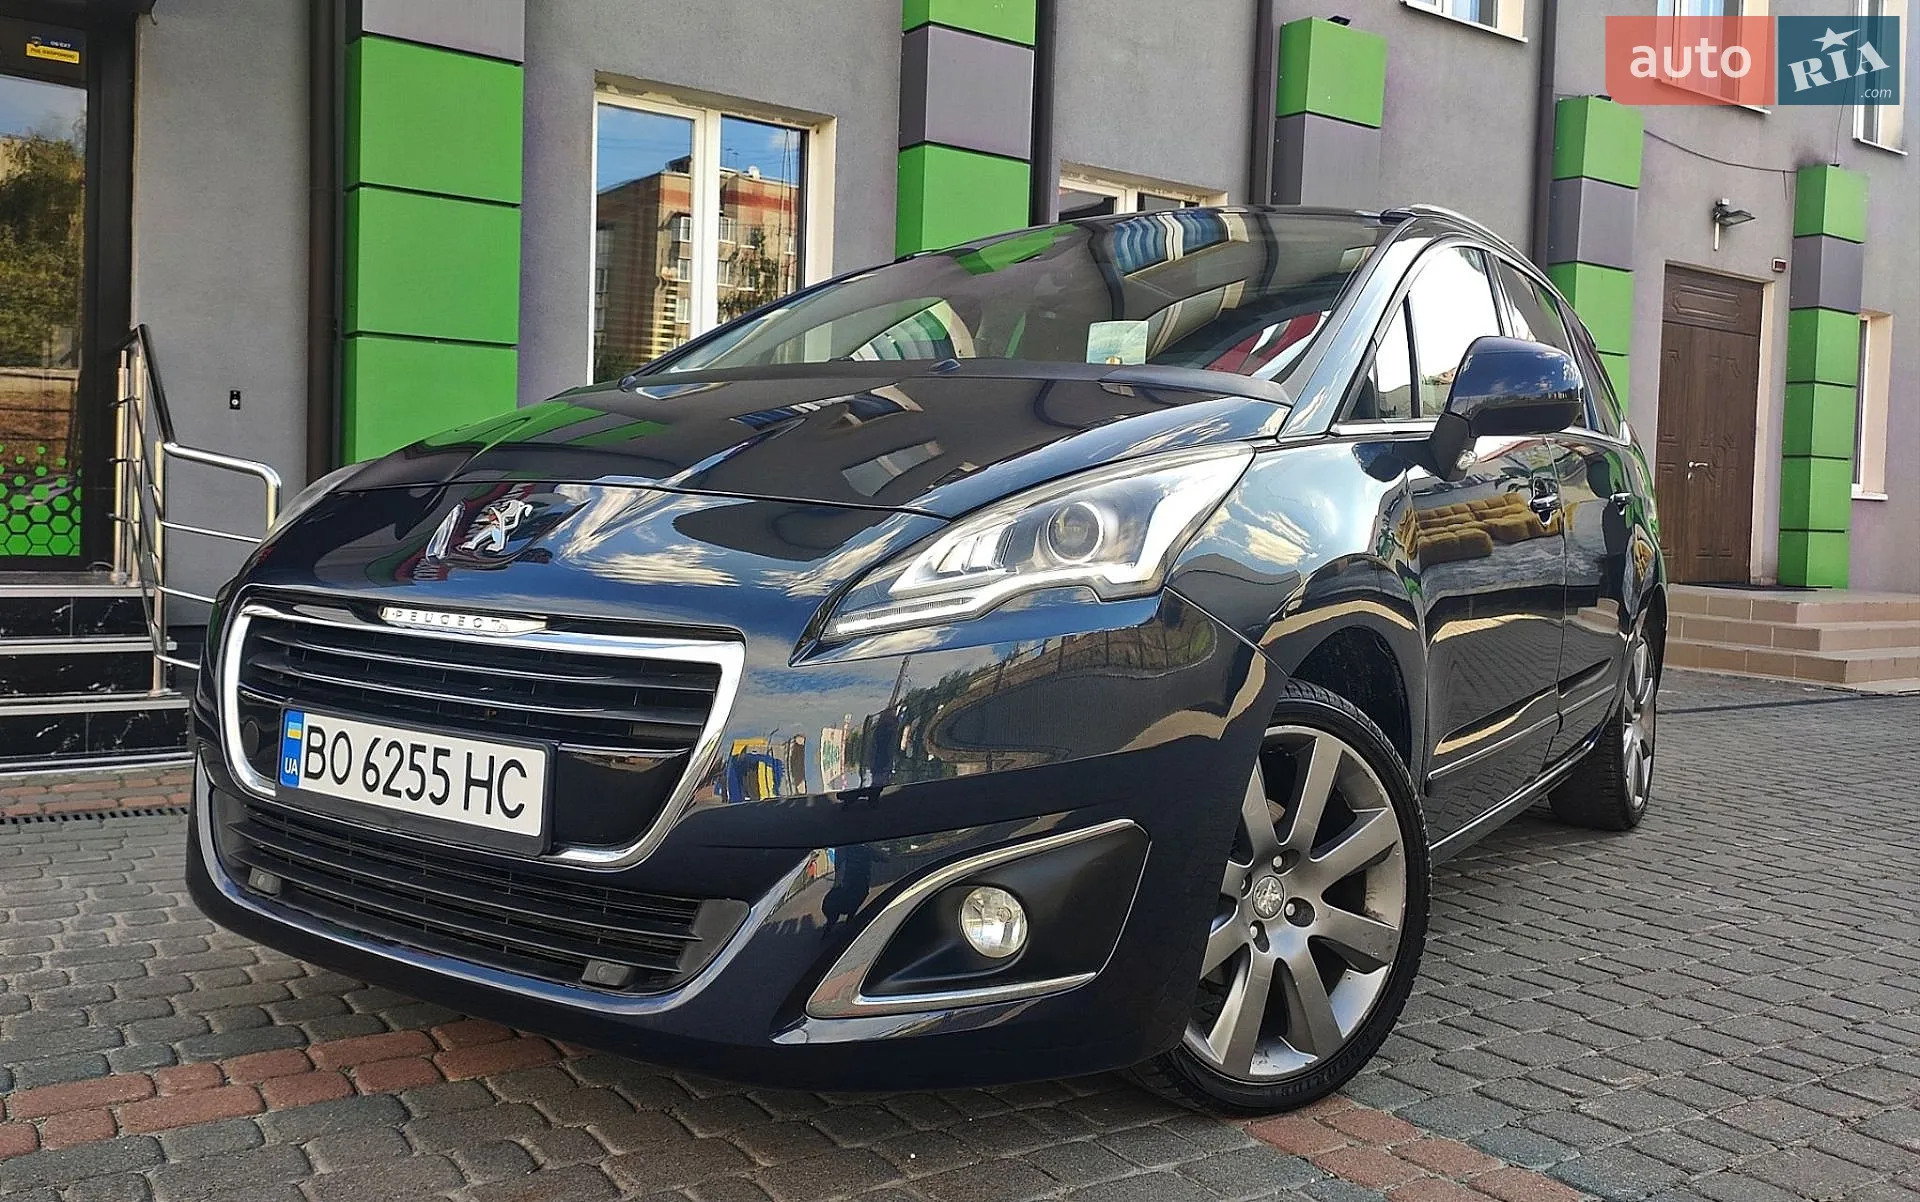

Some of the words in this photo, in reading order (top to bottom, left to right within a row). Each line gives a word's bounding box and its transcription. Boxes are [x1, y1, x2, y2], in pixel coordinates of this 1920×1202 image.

[393, 609, 501, 631] PEUGEOT
[284, 757, 298, 776] UA
[303, 725, 353, 785] BO
[361, 737, 451, 805] 6255
[463, 751, 527, 819] HC
